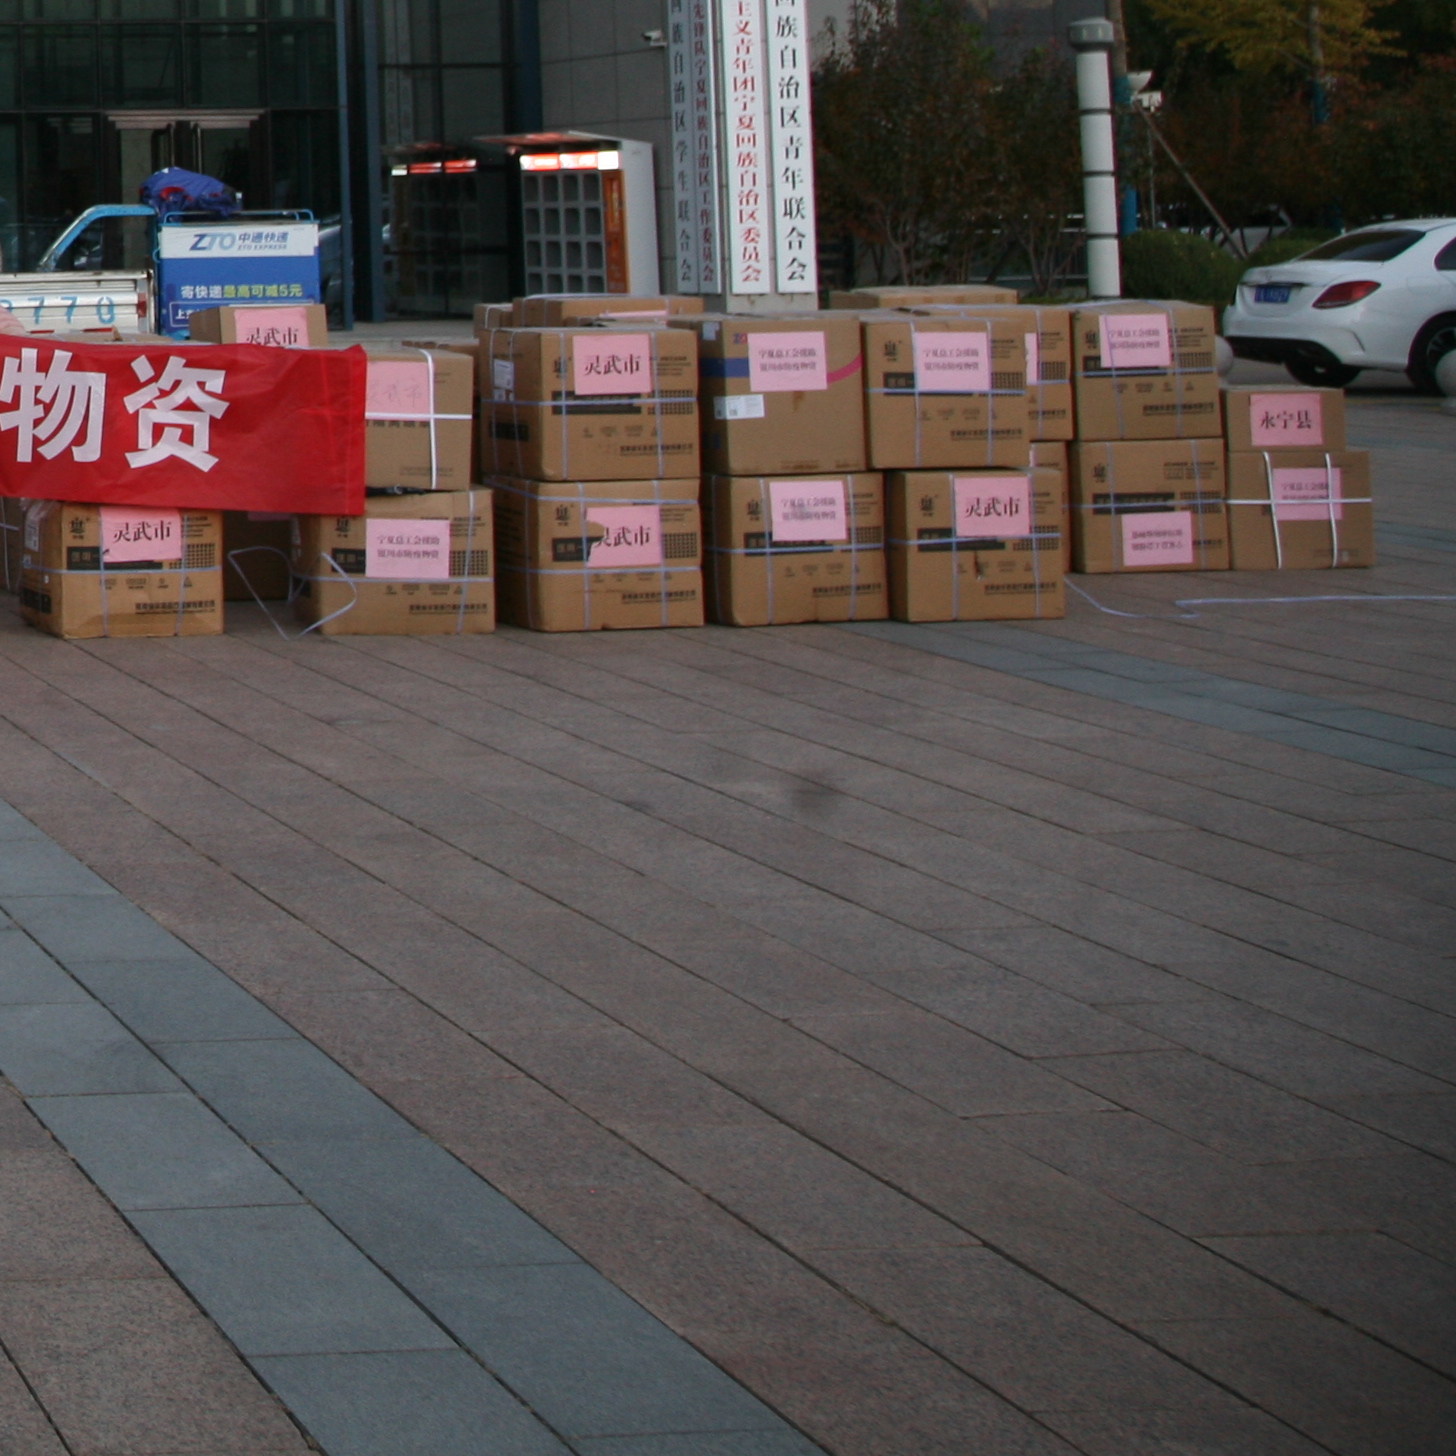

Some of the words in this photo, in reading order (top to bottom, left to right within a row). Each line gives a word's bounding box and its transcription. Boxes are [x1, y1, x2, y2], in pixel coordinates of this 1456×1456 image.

[190, 231, 237, 251] ZTO
[238, 231, 289, 243] 中通快递
[181, 284, 303, 298] 寄快递最高可减5元
[583, 355, 640, 376] 灵武市
[1260, 410, 1313, 430] 永宁县
[965, 496, 1020, 518] 灵武市
[113, 520, 172, 543] 灵武市
